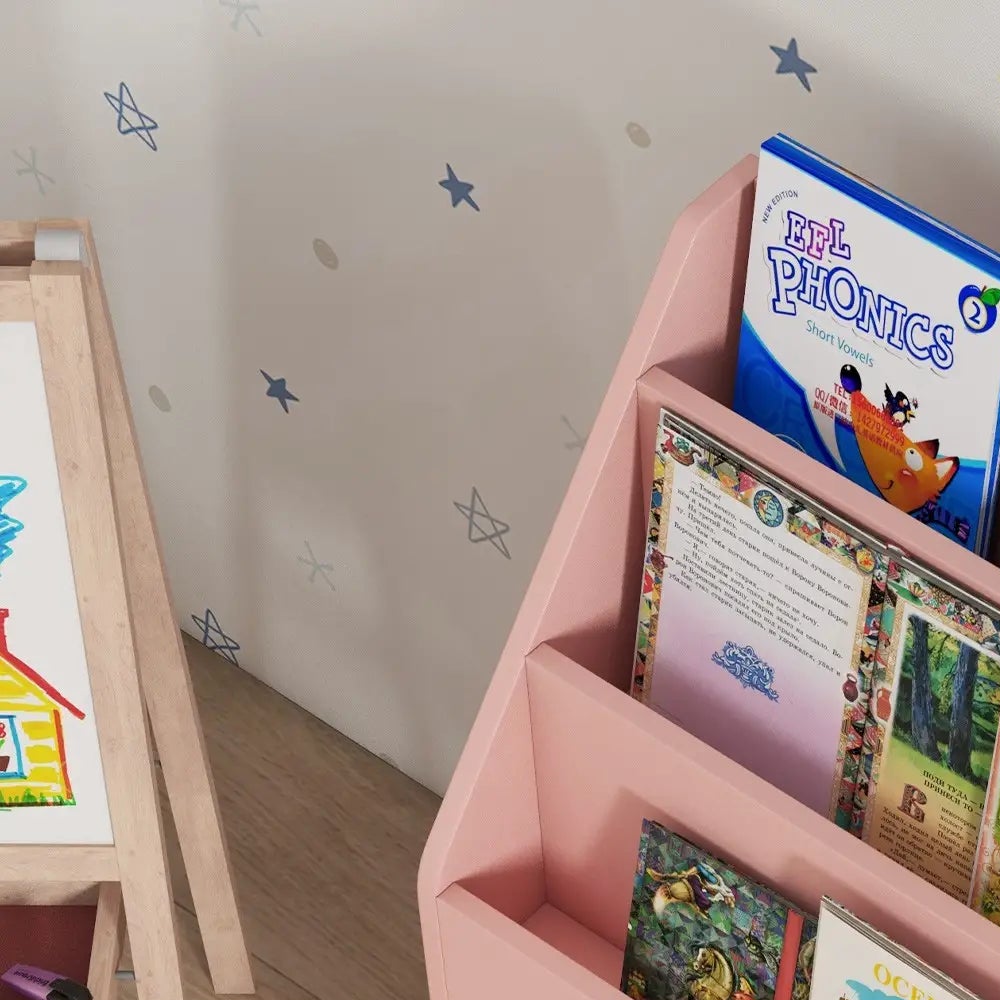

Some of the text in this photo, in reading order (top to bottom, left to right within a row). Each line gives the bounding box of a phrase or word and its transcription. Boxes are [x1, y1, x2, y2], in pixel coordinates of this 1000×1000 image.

[772, 189, 799, 206] EDITION
[785, 210, 850, 260] EFL
[767, 246, 954, 370] PHONICS
[969, 300, 981, 324] 2
[806, 319, 874, 368] Short Vowels
[738, 536, 760, 554] старик
[921, 769, 968, 801] ПОДИ ТУДА
[923, 779, 960, 805] ПРИНЕСИ
[962, 802, 973, 813] ТО
